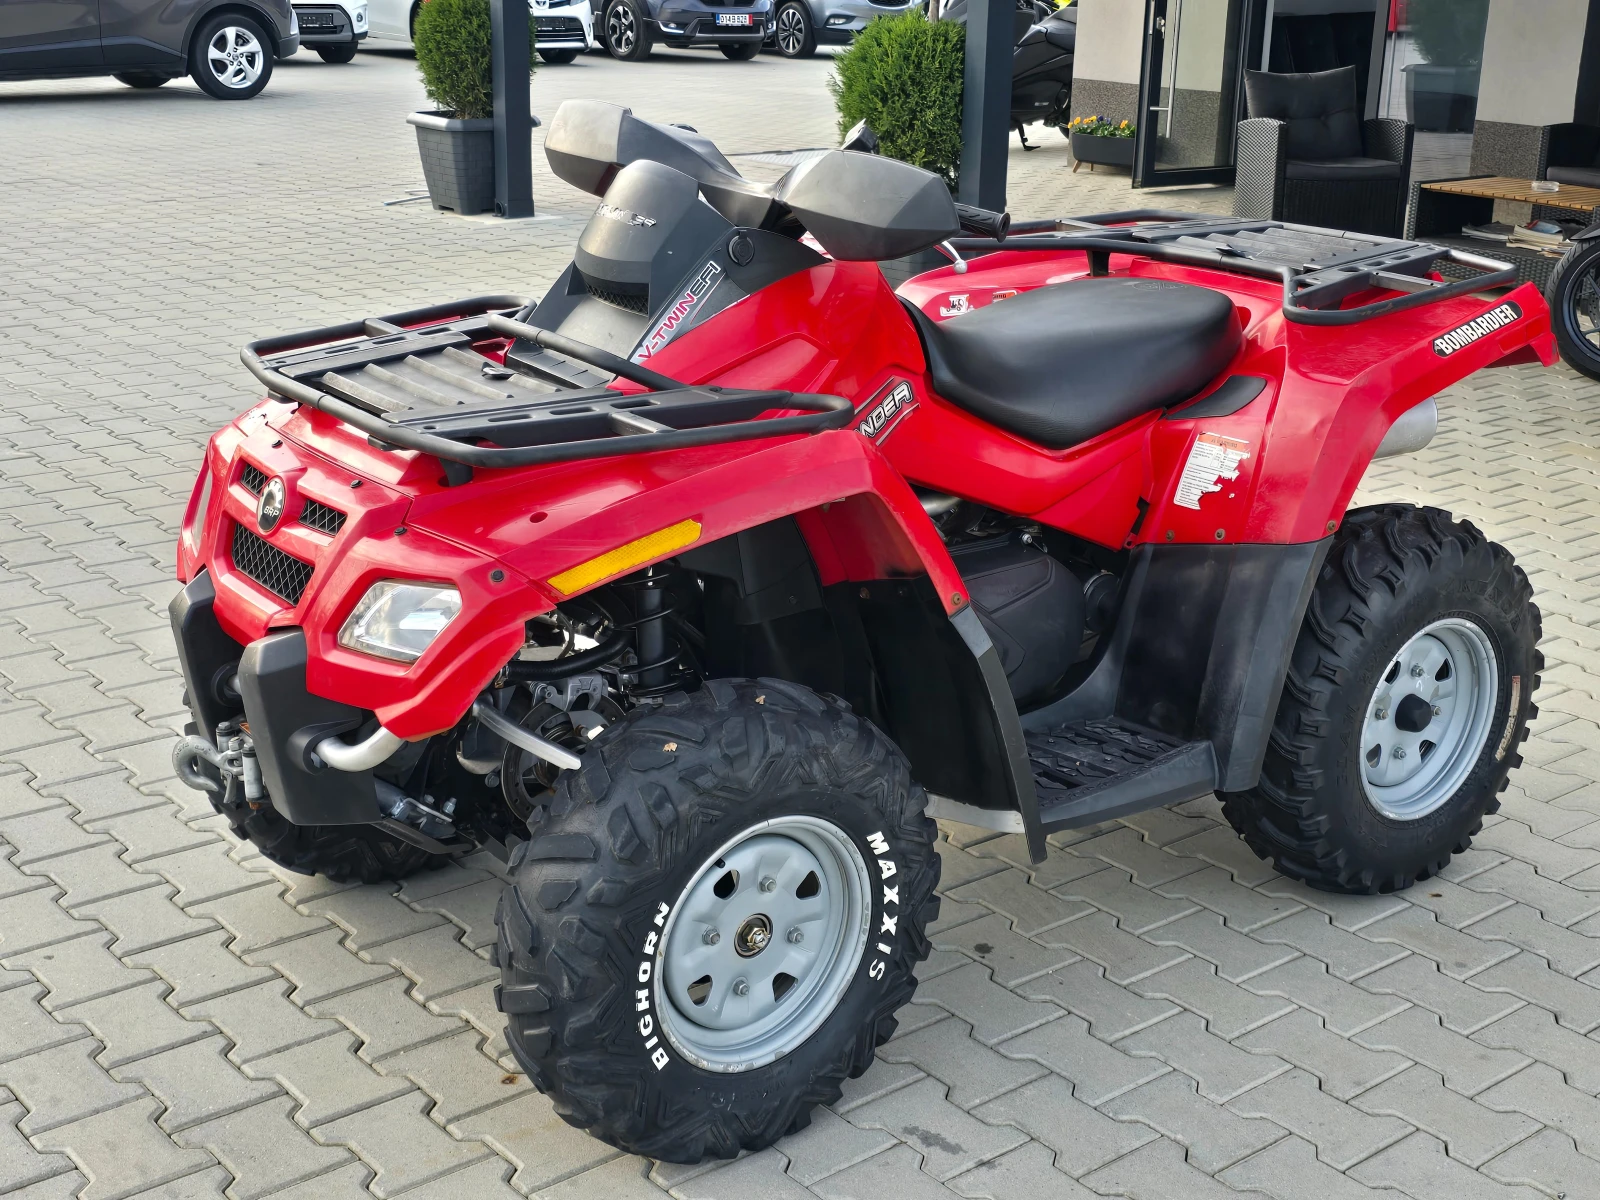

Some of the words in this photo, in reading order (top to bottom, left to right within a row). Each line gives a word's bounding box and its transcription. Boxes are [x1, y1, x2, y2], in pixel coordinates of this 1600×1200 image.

[1435, 304, 1518, 355] BOMBARDIER
[263, 505, 280, 518] BRP
[866, 831, 900, 981] MAXXIS
[635, 901, 670, 1071] BIGHORN
